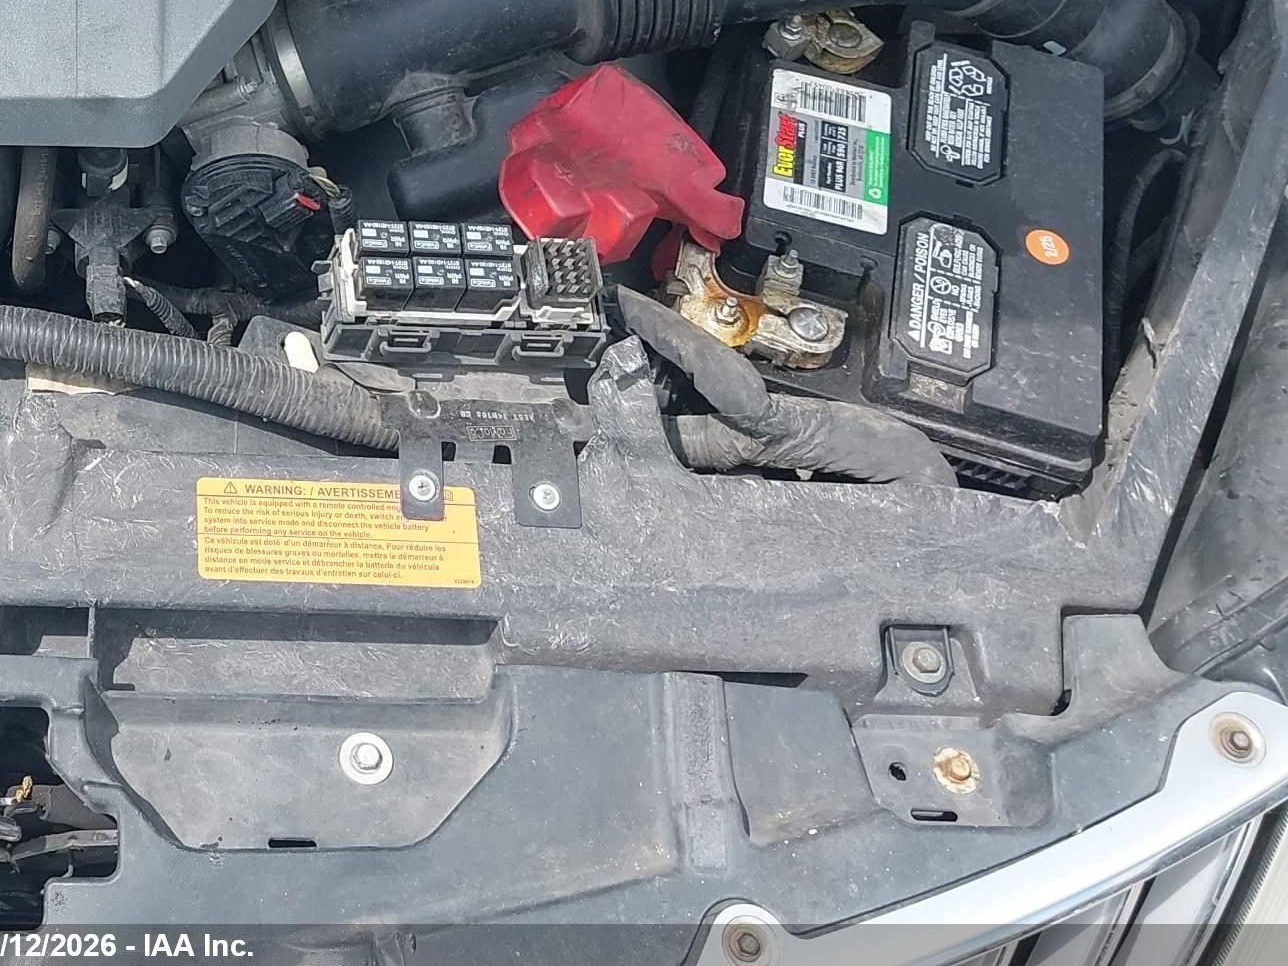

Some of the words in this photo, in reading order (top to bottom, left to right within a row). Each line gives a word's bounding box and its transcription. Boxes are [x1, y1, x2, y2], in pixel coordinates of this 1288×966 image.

[837, 126, 847, 139] 725
[772, 113, 796, 177] EverStart
[836, 144, 846, 157] 590
[834, 174, 844, 190] PLUS
[1040, 235, 1058, 257] 2/25
[914, 233, 929, 273] POISON
[951, 286, 959, 296] NO
[908, 283, 924, 328] DANGER
[244, 484, 306, 496] WARNING:
[317, 487, 401, 499] AVERTISSEME
[221, 498, 248, 506] vehicle
[258, 499, 293, 509] equipped
[295, 500, 311, 508] with
[319, 502, 345, 510] remote
[347, 503, 385, 511] controlled
[387, 505, 402, 514] eng
[214, 507, 240, 515] reduce
[311, 510, 333, 519] injury
[370, 512, 394, 520] switch
[204, 516, 231, 525] system
[301, 519, 315, 527] and
[317, 520, 358, 528] disconnect
[360, 521, 372, 529] the
[374, 522, 401, 530] vehicle
[402, 523, 429, 533] battery
[204, 525, 228, 533] before
[230, 526, 272, 536] performing
[204, 547, 233, 556] risques
[246, 548, 283, 556] blessures
[386, 543, 404, 551] Pour
[204, 556, 237, 564] distance
[286, 568, 315, 576] travaux
